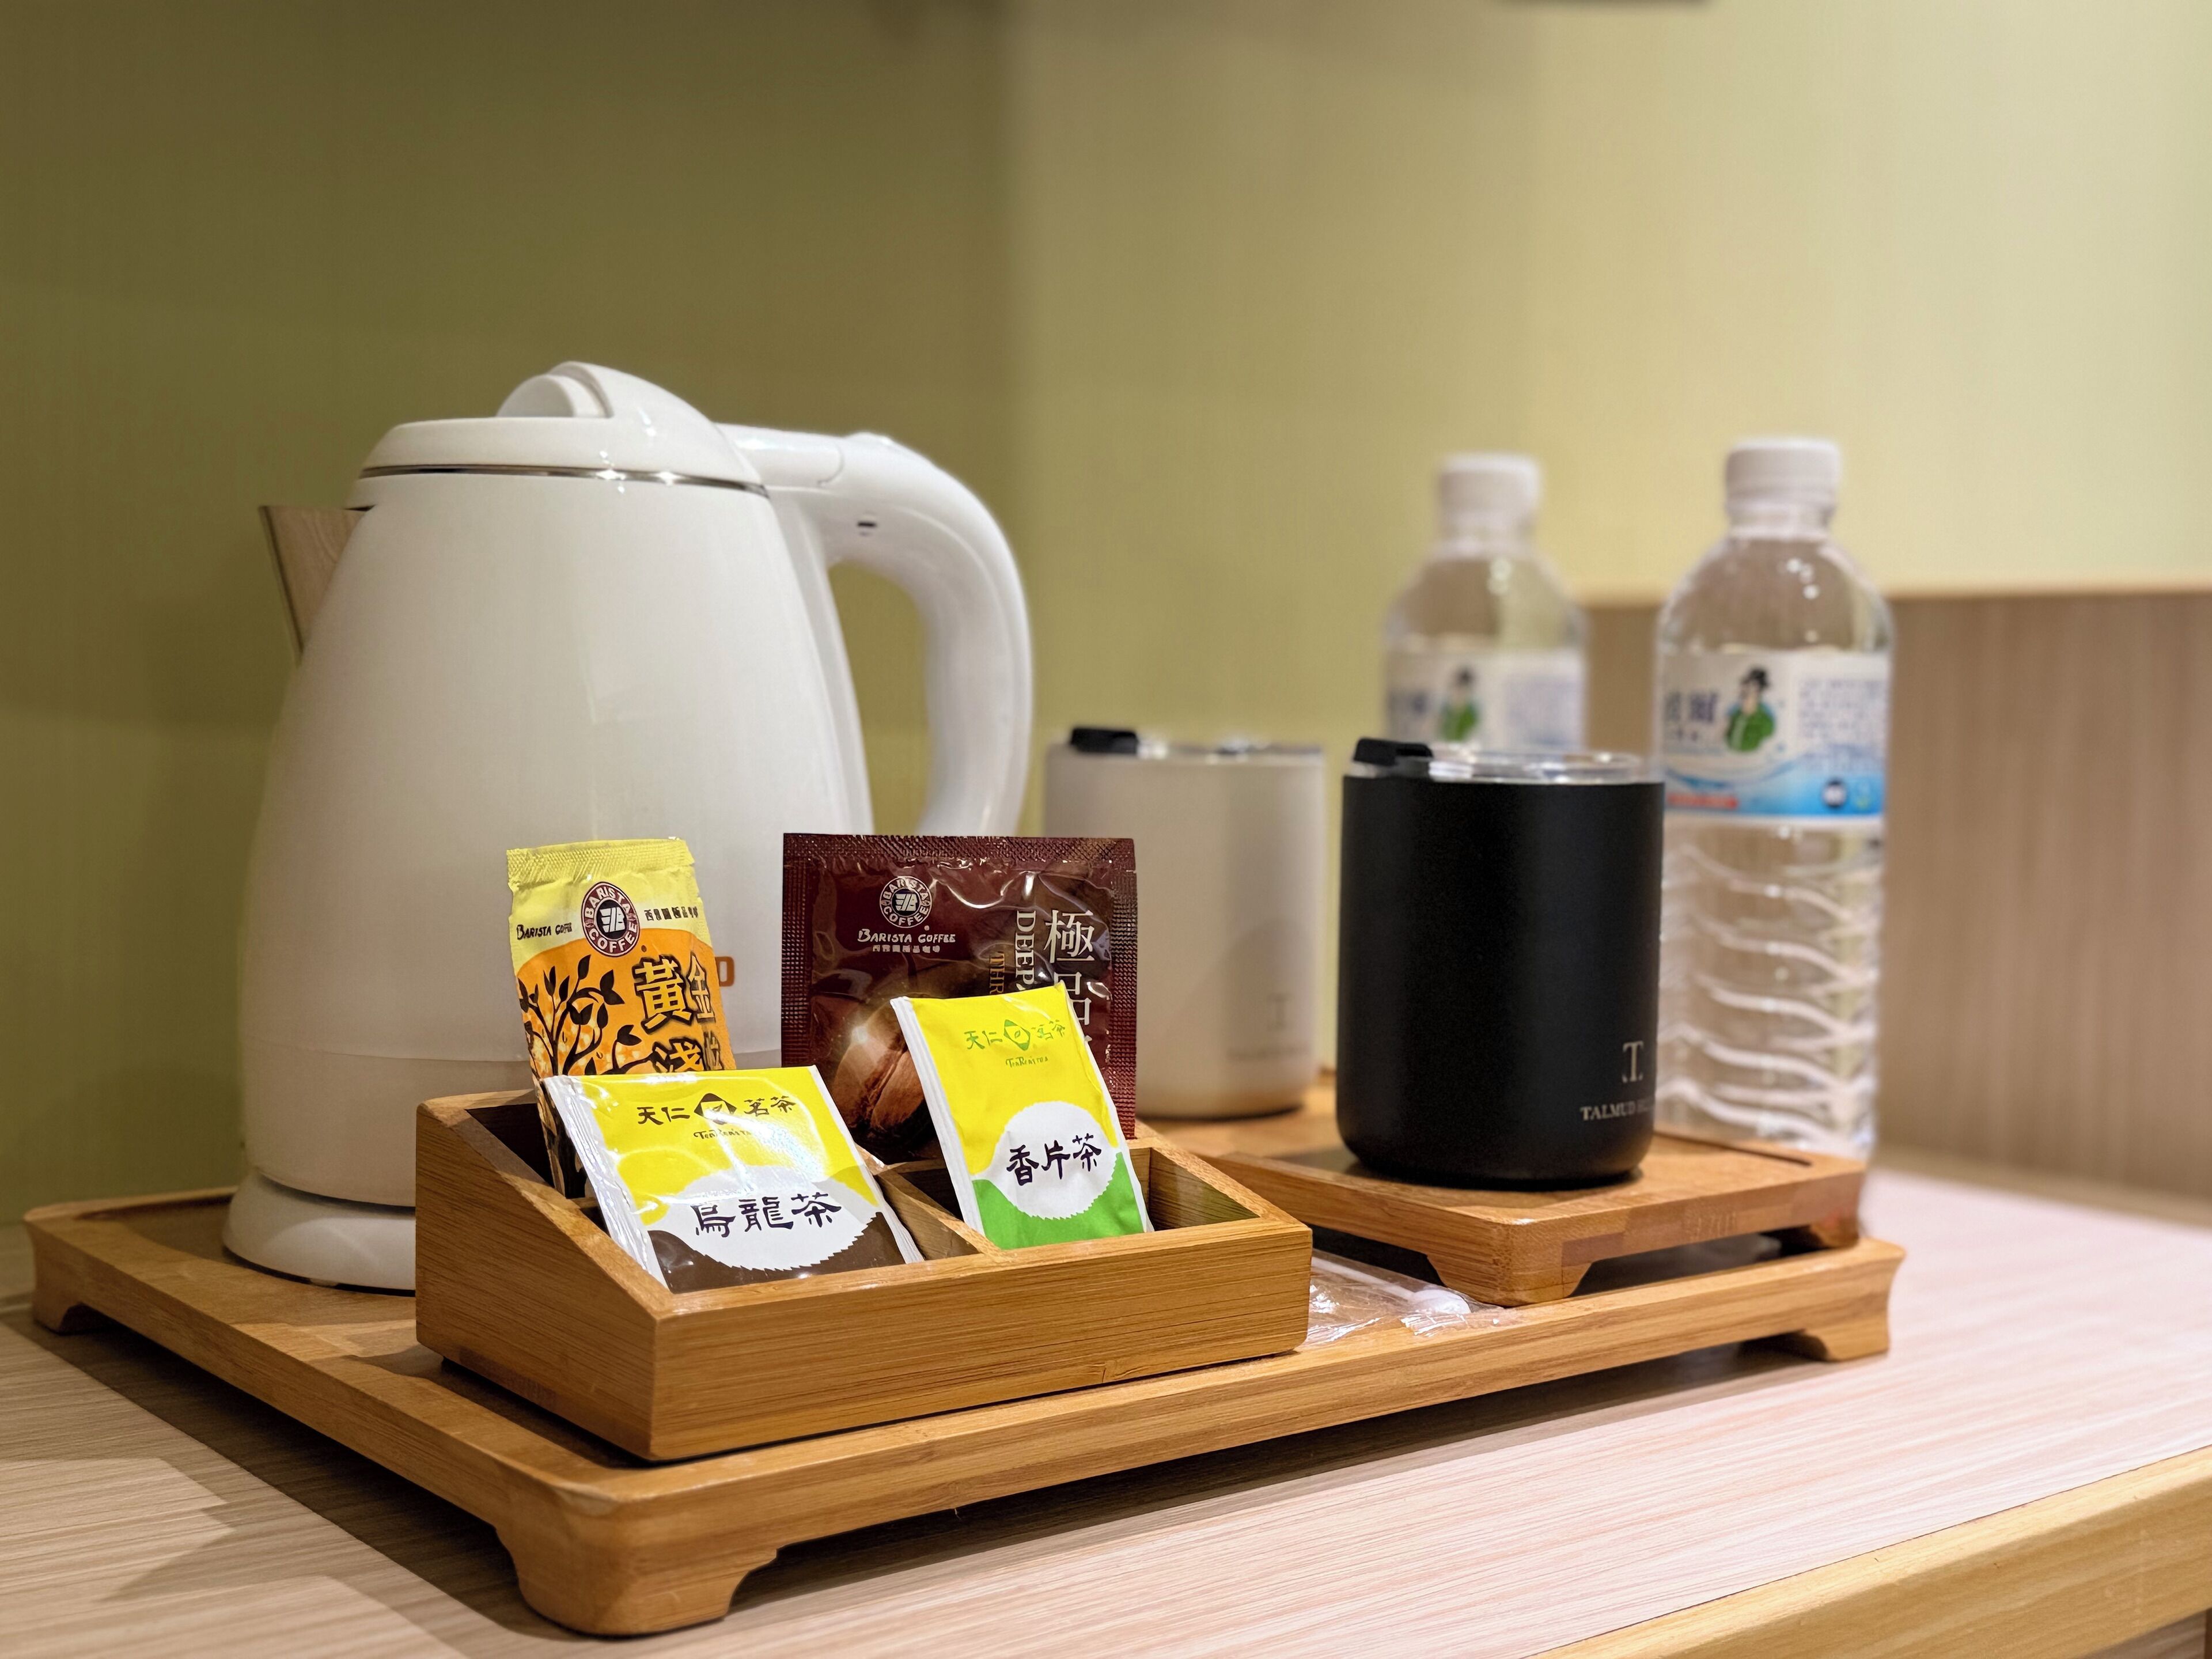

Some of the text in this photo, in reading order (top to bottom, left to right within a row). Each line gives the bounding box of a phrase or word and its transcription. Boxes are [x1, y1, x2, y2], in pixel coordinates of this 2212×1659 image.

[585, 886, 631, 918] BARISTA
[884, 906, 929, 926] COFFEE
[589, 922, 638, 953] COFFEE
[857, 928, 956, 944] BARISTA COFFEE
[1016, 910, 1036, 985] DEEP
[964, 1030, 1003, 1050] 天仁
[637, 1096, 797, 1125] 天仁 茗茶
[1006, 1132, 1102, 1186] 香片茶
[690, 1192, 842, 1237] 烏龍茶
